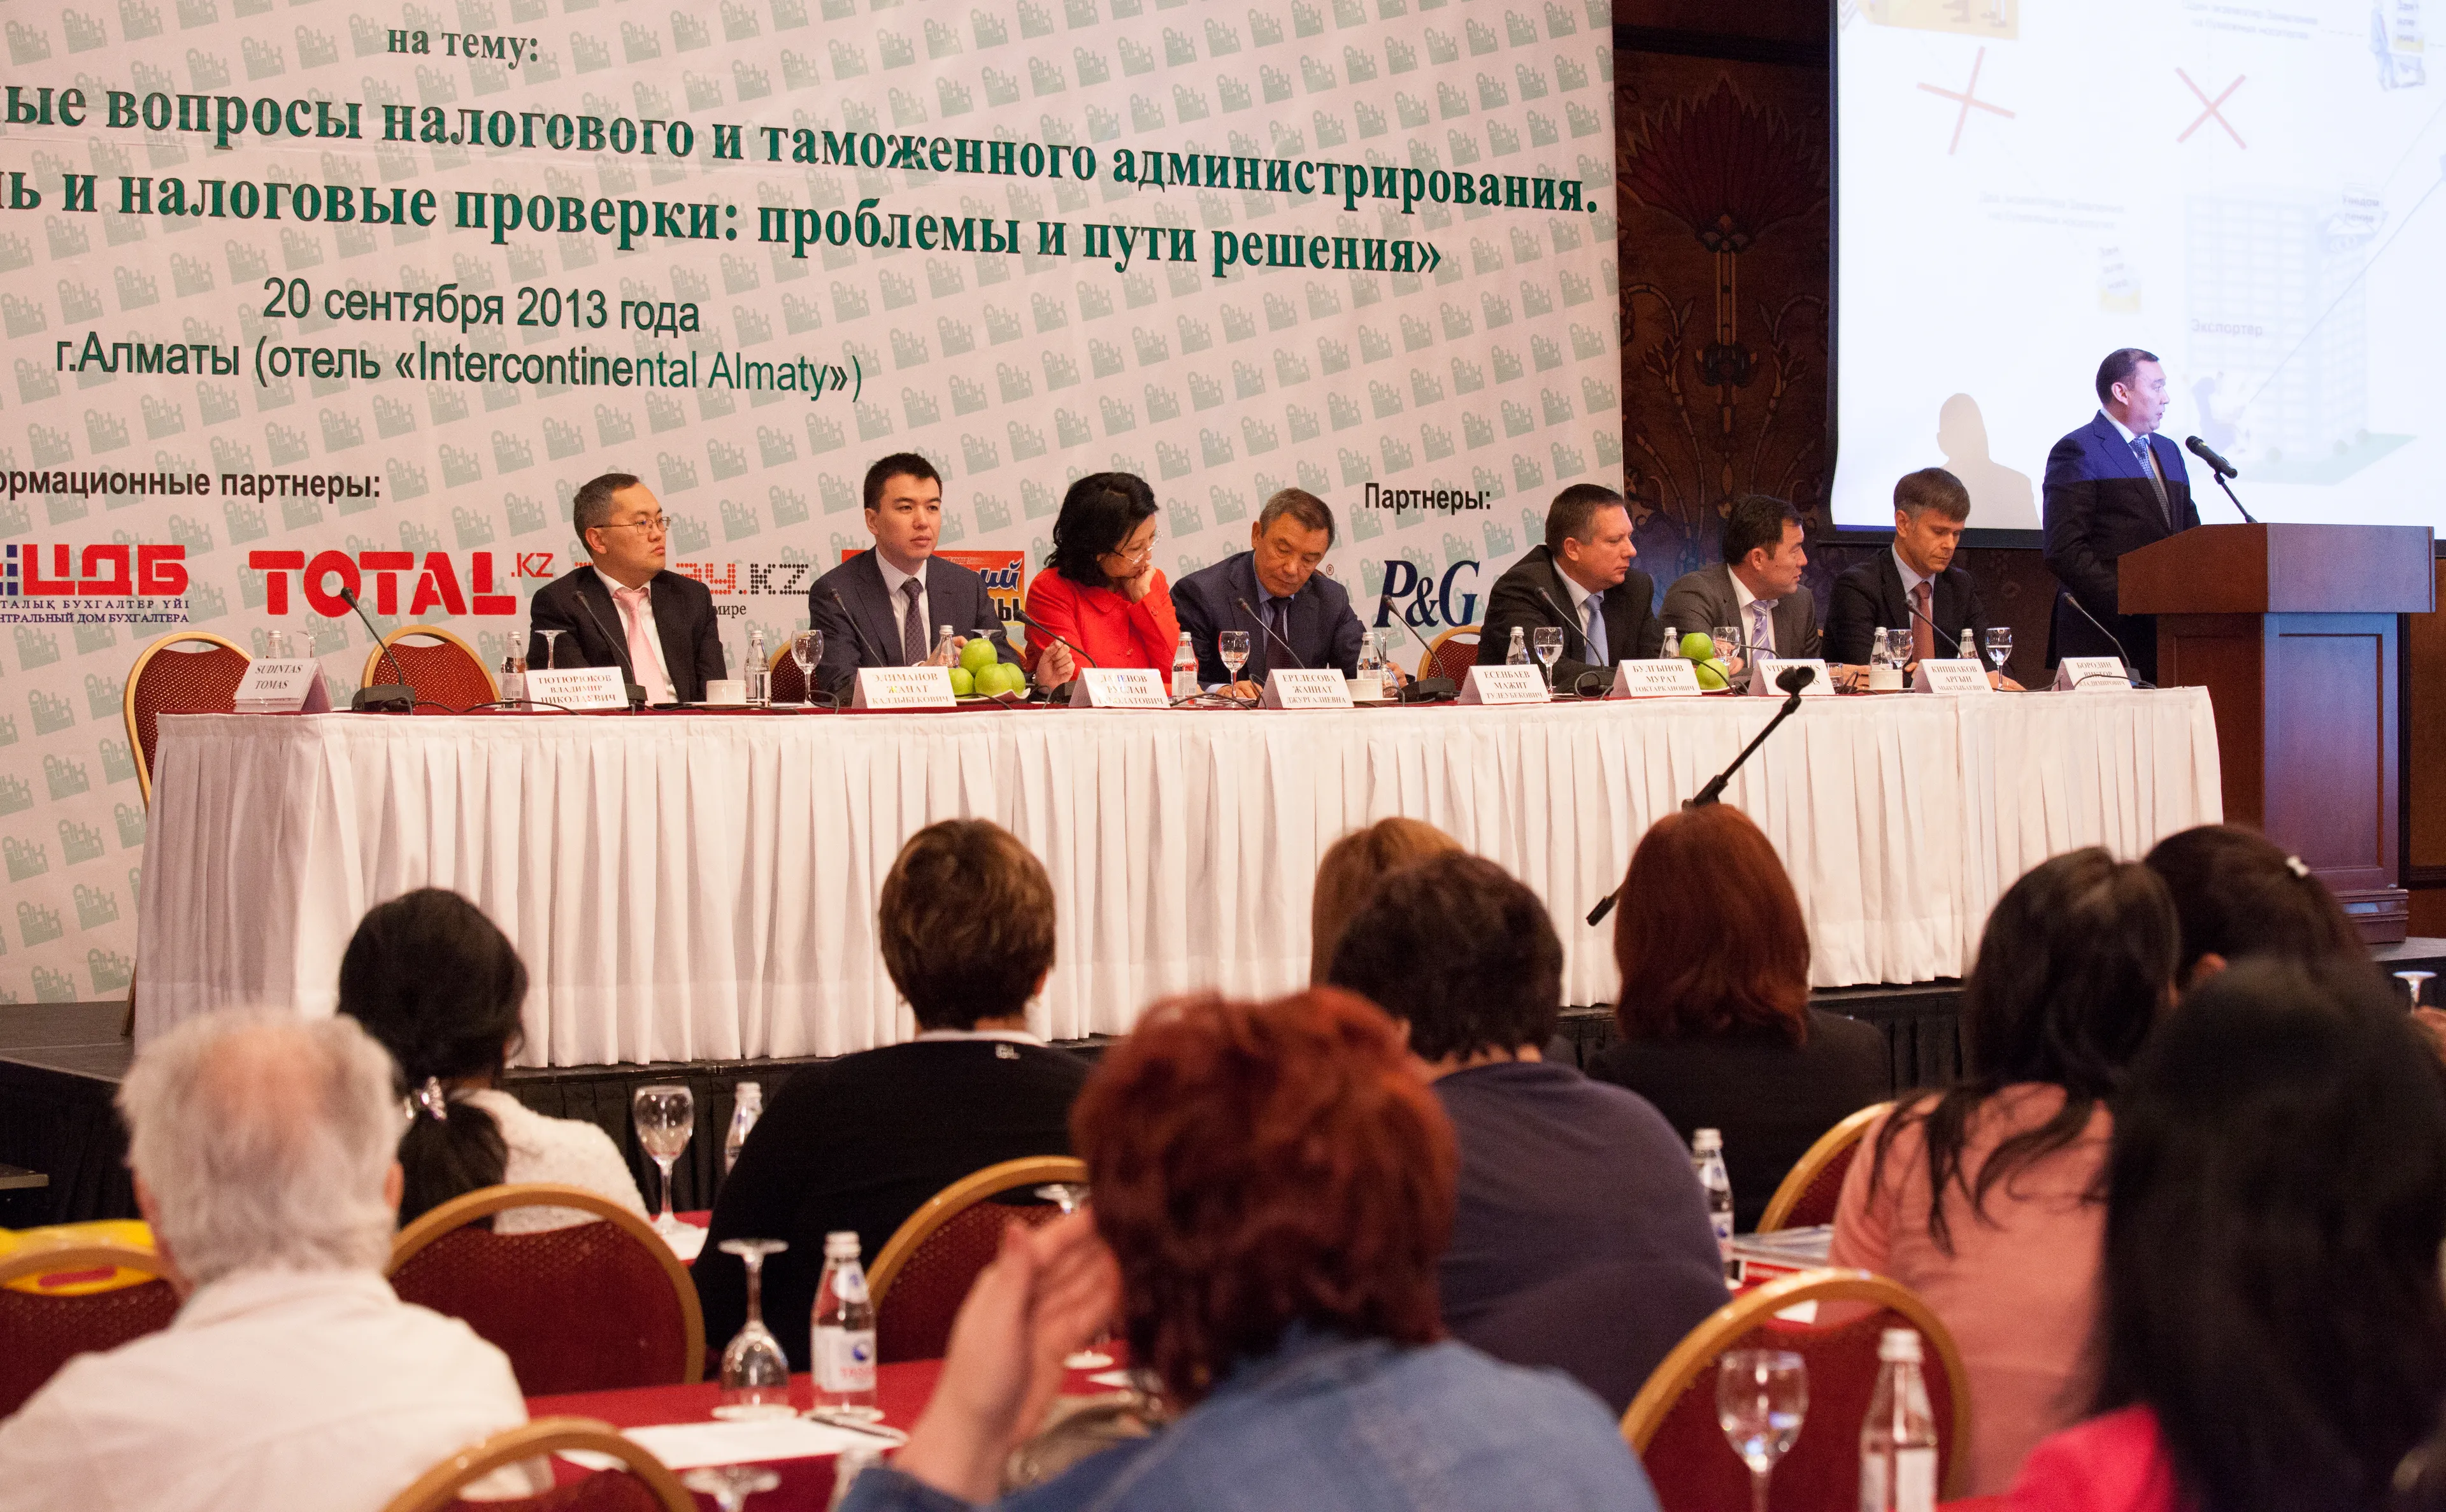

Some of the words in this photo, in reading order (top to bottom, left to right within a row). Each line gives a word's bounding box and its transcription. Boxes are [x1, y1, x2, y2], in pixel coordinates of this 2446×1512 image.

[387, 29, 429, 54] на
[441, 32, 538, 67] тему:
[0, 85, 86, 127] ые
[106, 90, 362, 149] вопросы
[382, 104, 694, 157] налогового
[712, 124, 743, 160] и
[760, 127, 1096, 182] таможенного
[1113, 148, 1598, 215] администрирования.
[0, 171, 41, 210] ь
[62, 174, 98, 212] и
[118, 176, 436, 229] налоговые
[455, 191, 737, 251] проверки:
[757, 197, 1020, 259] проблемы
[1037, 221, 1067, 256] и
[1083, 224, 1197, 273] пути
[1211, 231, 1441, 278] решения»
[263, 277, 310, 318] 20
[324, 283, 503, 334] сентября
[517, 287, 607, 329] 2013
[621, 301, 699, 339] года
[57, 331, 239, 375] г.Алматы
[255, 336, 381, 388] (отель
[395, 341, 697, 389] «Intercontinental
[708, 352, 862, 403] Almaty»)
[222, 473, 380, 504] партнеры:
[1365, 482, 1492, 516] Партнеры:
[1372, 560, 1480, 628] P&G
[62, 600, 155, 610] БУХГАЛТЕР
[0, 611, 75, 623] НТРАЛЬНЫЙ
[76, 613, 106, 625] ДОМ
[108, 613, 190, 624] БУХГАЛТЕРА
[255, 664, 303, 674] SUDINTAS
[2075, 661, 2113, 669] БОРОДИН
[536, 674, 612, 685] ТЮТЮРЮКОВ
[872, 673, 938, 682] ЭЛИМАНОВ
[1282, 674, 1337, 683] ЕРТЛЕСОВА
[1484, 670, 1531, 679] ЕСЕНБАЕВ
[1645, 674, 1677, 683] МУРАТ
[1945, 675, 1973, 683] АРГЫН
[255, 680, 289, 690] TOMAS
[550, 684, 603, 694] ВЛАДИМИР
[886, 684, 929, 694] ЖАНАТ
[1292, 685, 1333, 694] ЖАННАТ
[1493, 681, 1527, 690] МАЖИТ
